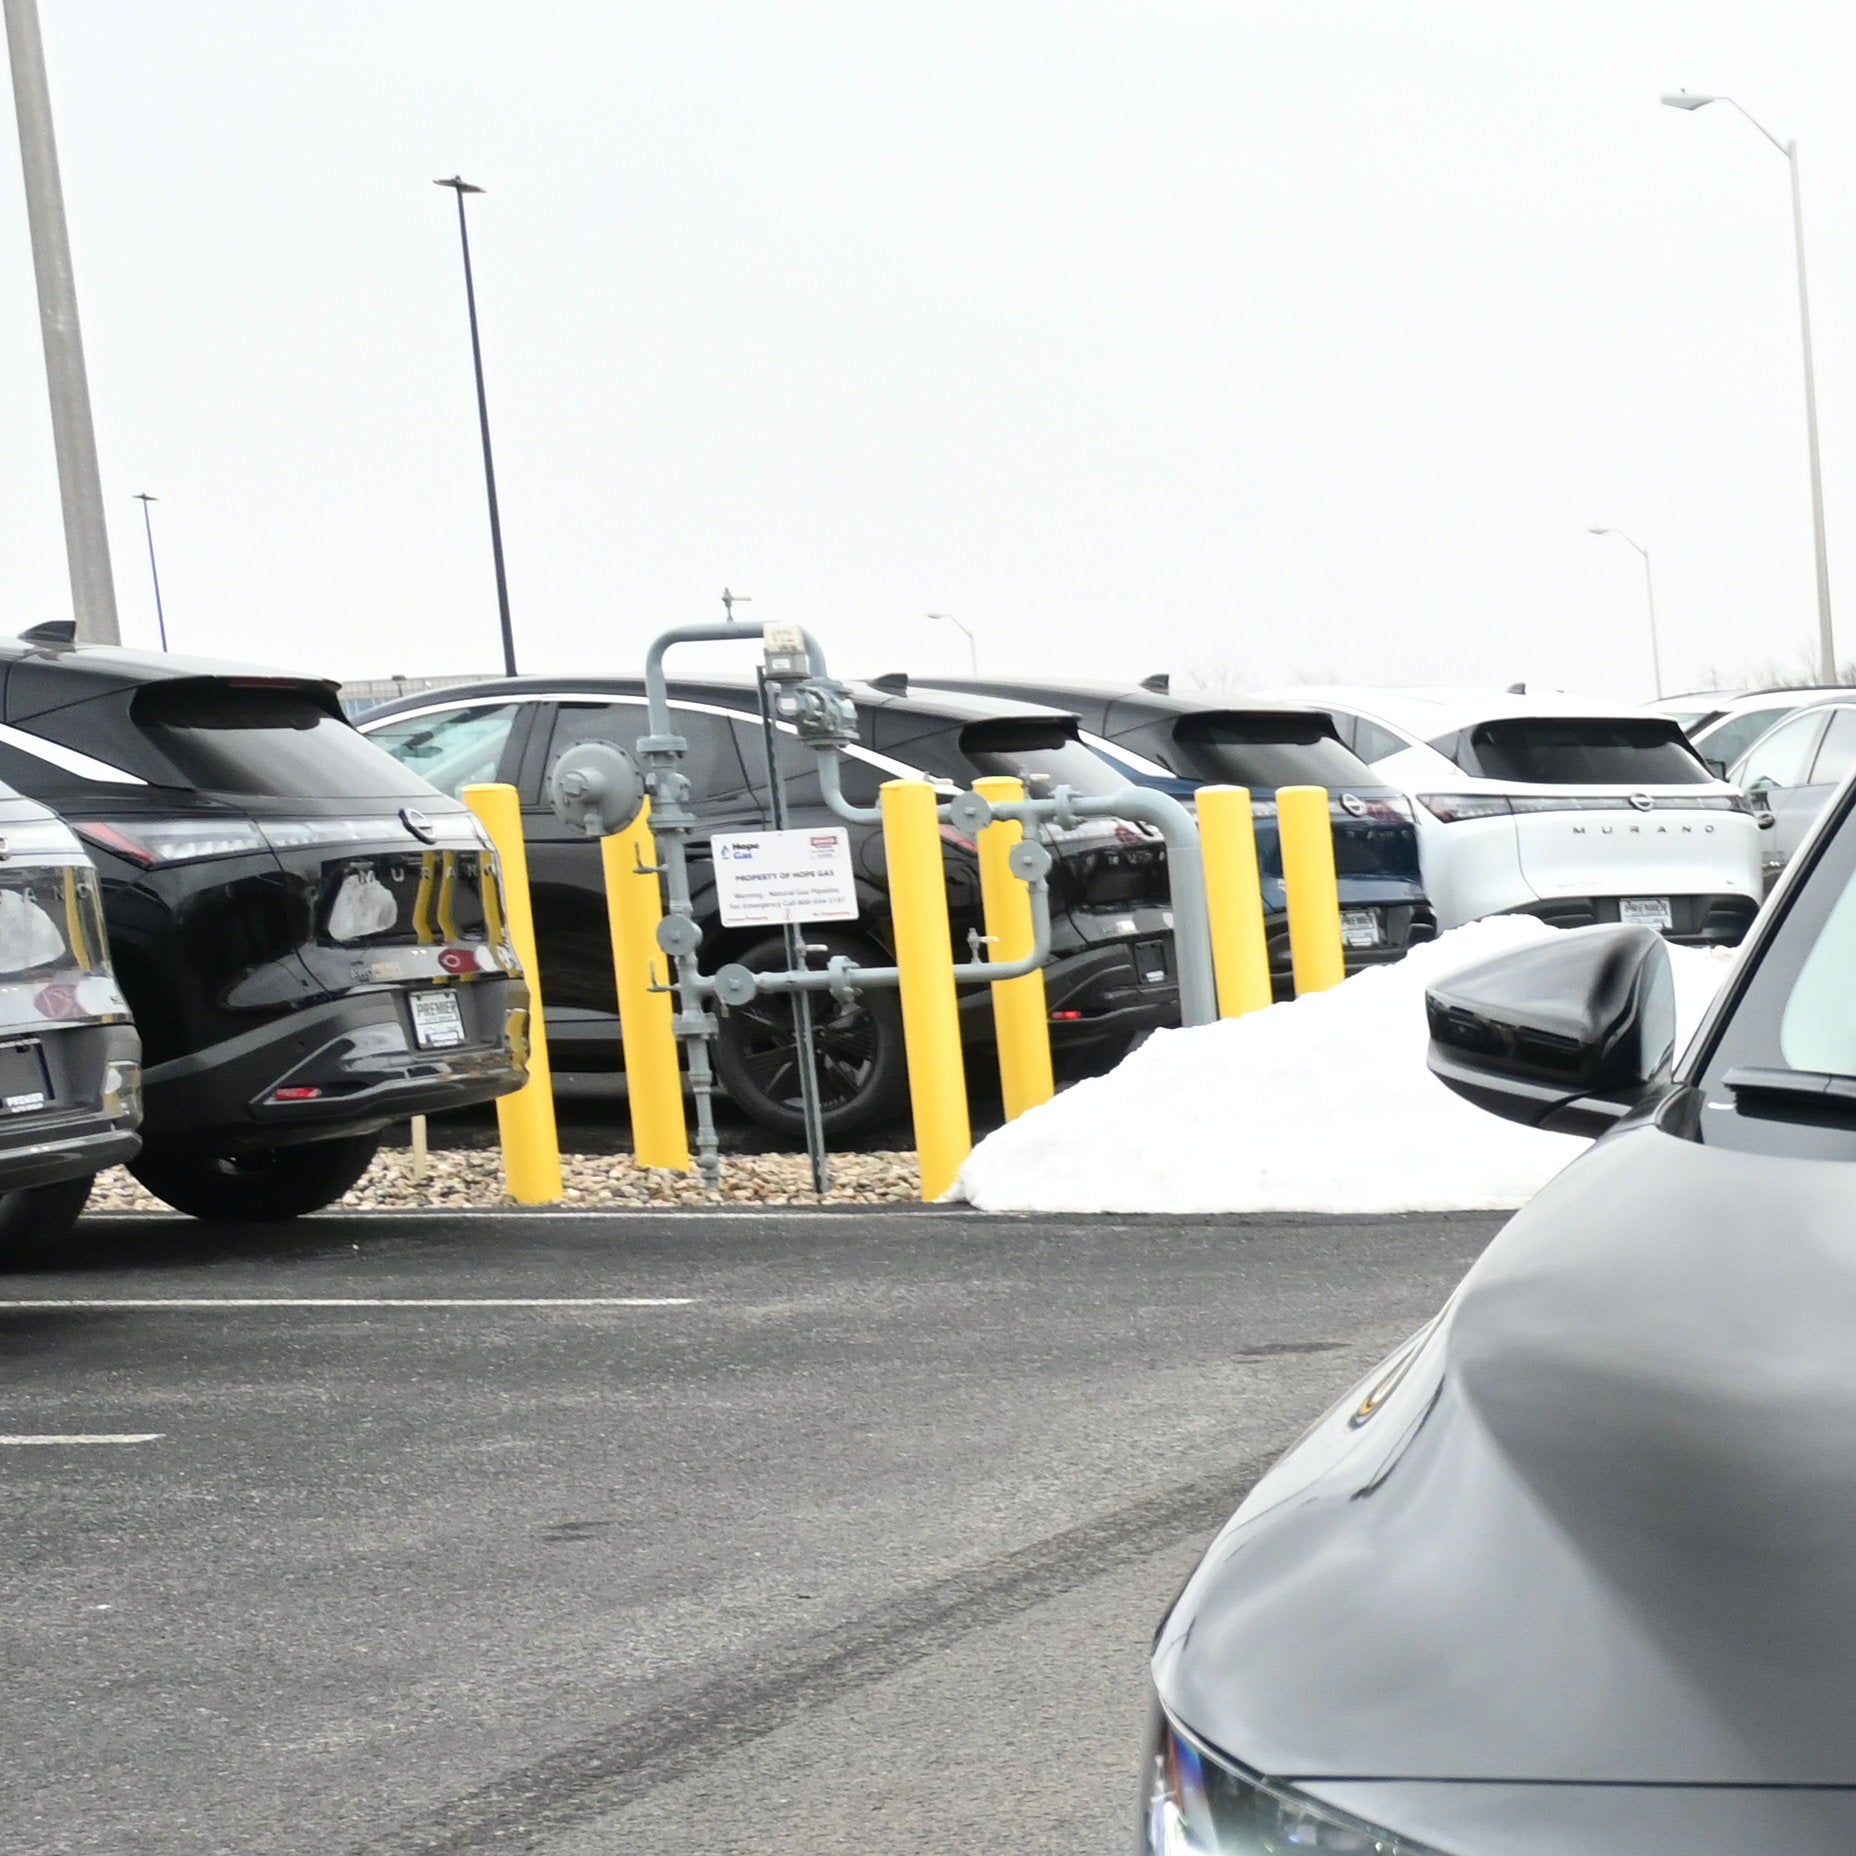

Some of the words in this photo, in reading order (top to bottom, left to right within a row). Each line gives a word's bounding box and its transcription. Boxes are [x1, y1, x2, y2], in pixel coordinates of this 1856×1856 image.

[1572, 826, 1715, 835] MURANO
[732, 842, 759, 851] Hope
[735, 872, 778, 882] PROPERTY
[779, 872, 790, 880] OF
[793, 870, 816, 879] HOPE
[817, 869, 835, 878] GAS
